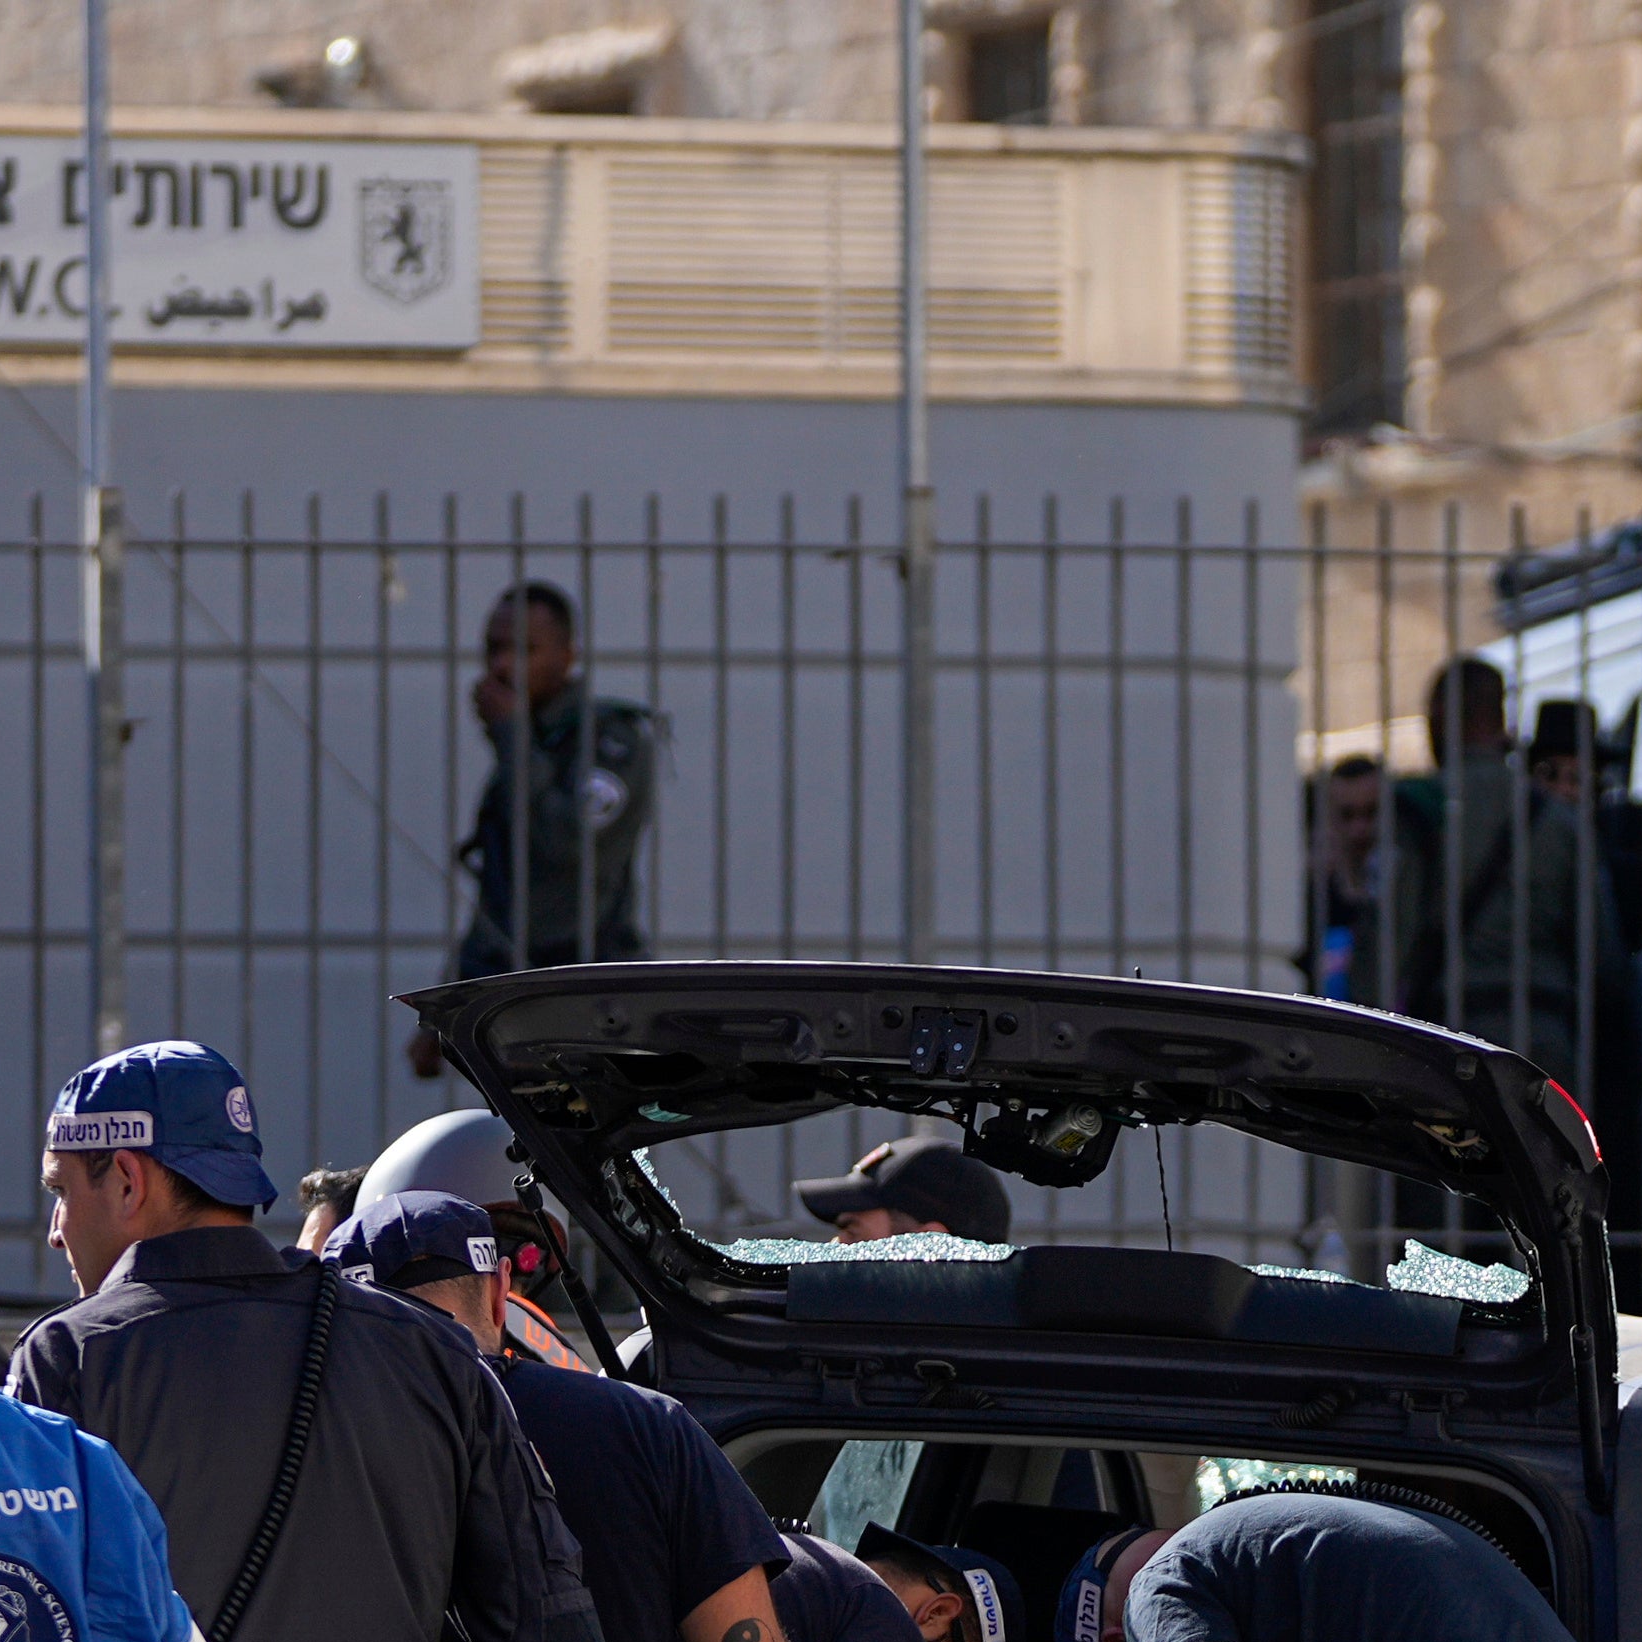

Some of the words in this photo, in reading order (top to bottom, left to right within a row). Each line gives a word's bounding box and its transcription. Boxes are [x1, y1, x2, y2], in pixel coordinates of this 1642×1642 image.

[63, 160, 330, 228] שירותים
[146, 273, 328, 333] مراحيض
[106, 1116, 145, 1146] חבלן
[973, 1574, 998, 1636] משטרה
[1078, 1589, 1098, 1631] חבלן
